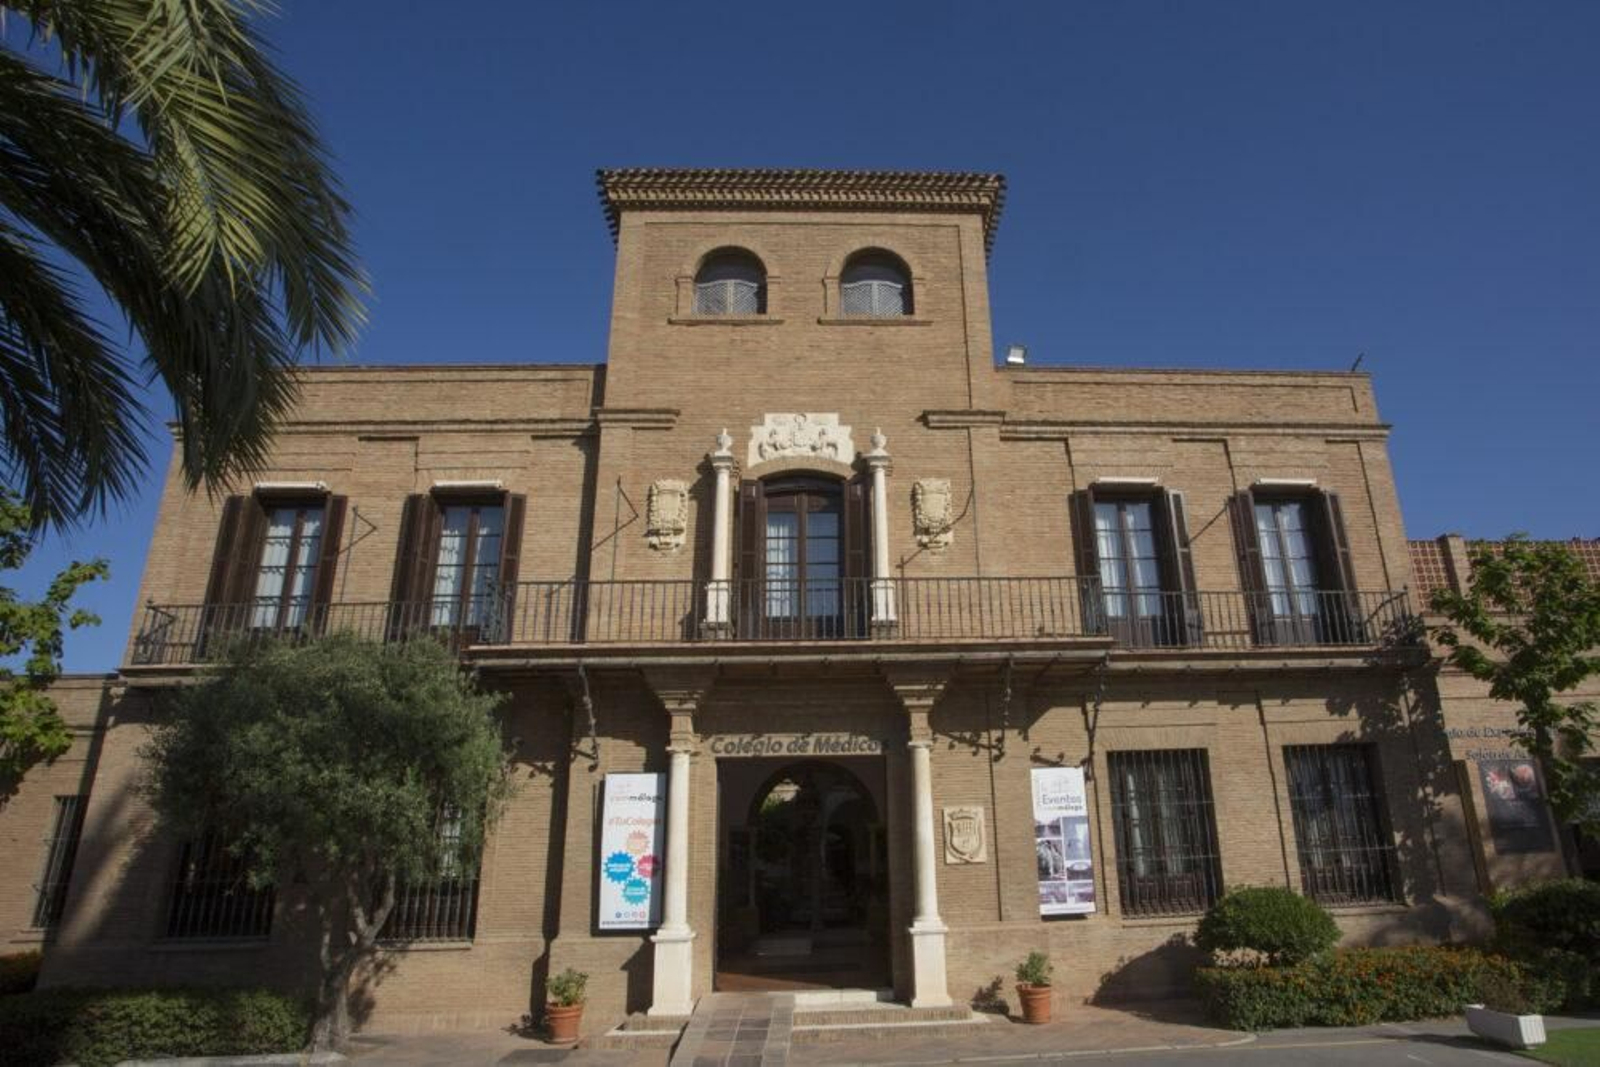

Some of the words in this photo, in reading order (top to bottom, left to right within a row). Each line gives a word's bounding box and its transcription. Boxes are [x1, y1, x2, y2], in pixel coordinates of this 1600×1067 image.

[711, 736, 782, 755] Colegio
[786, 736, 809, 753] de
[1042, 794, 1082, 805] Eventos
